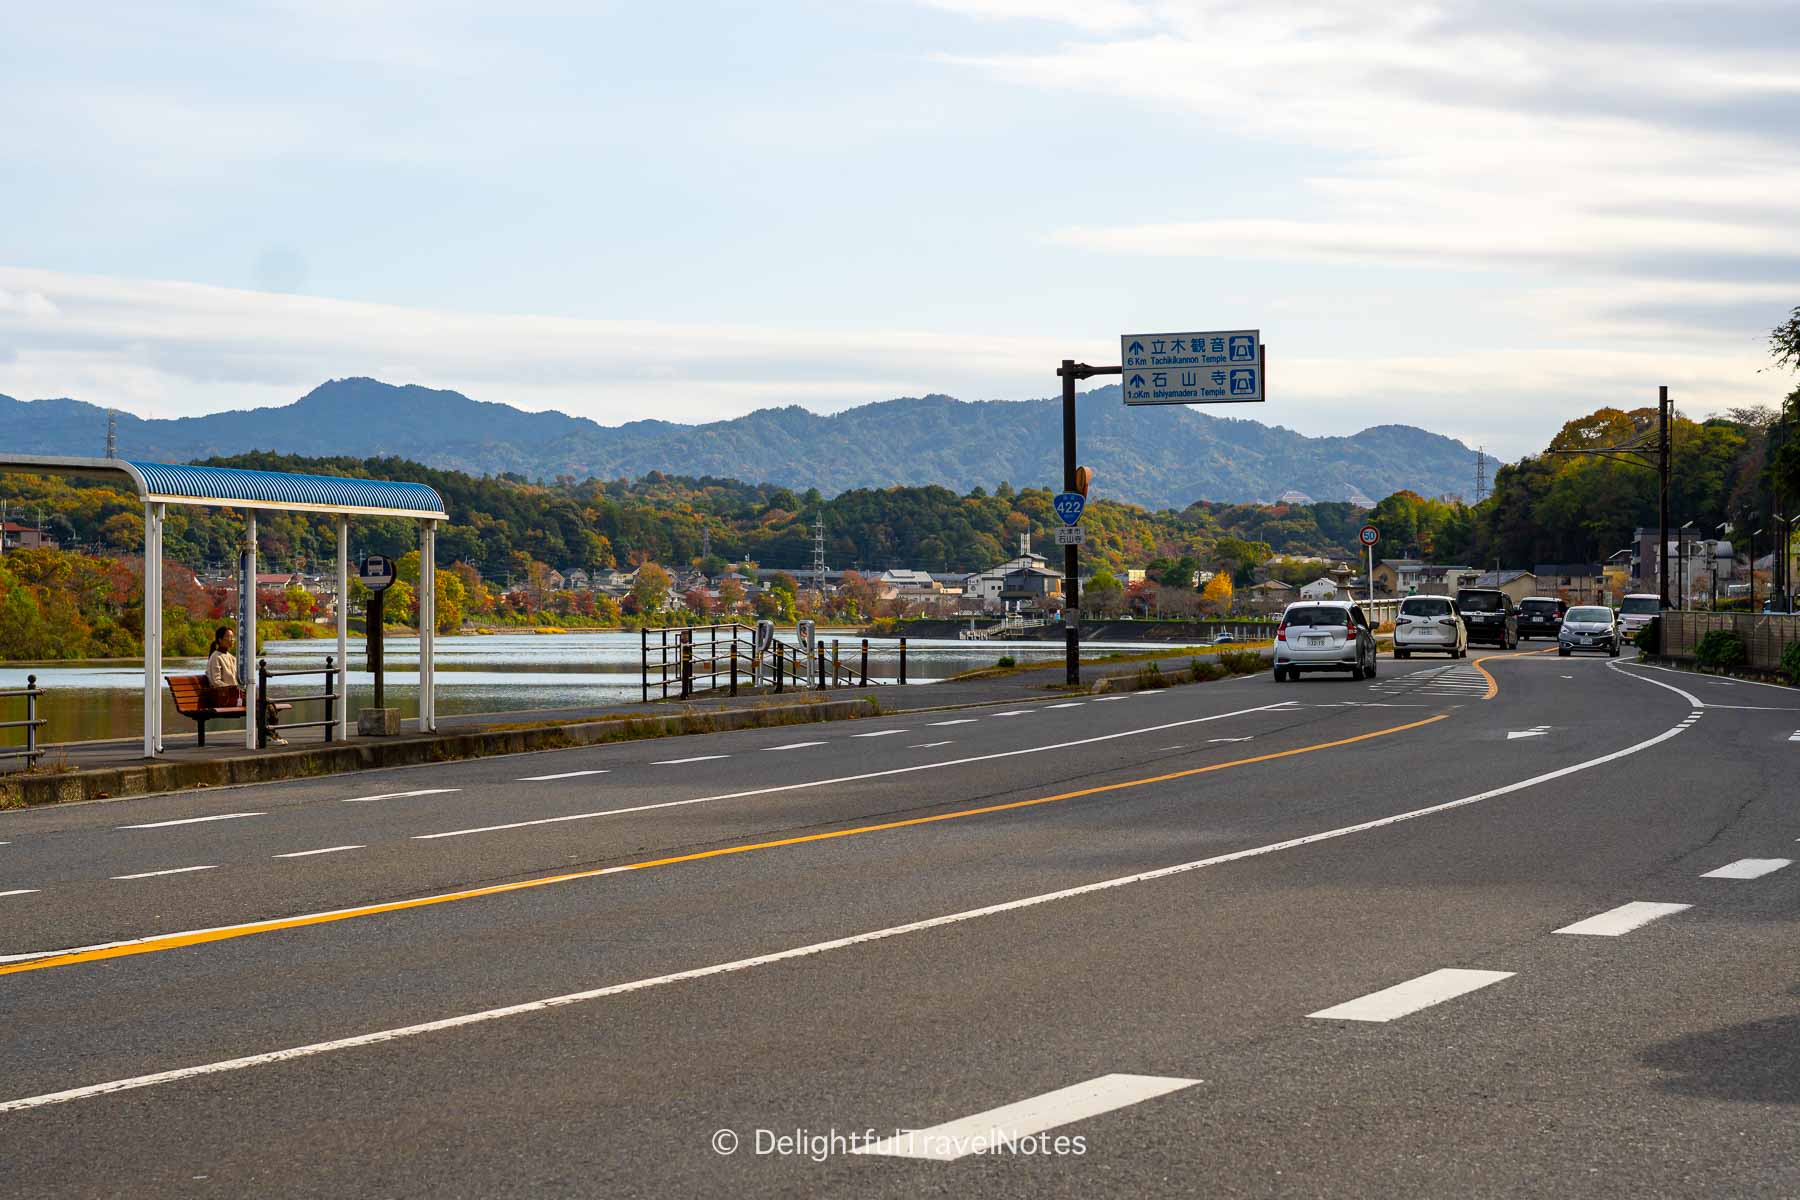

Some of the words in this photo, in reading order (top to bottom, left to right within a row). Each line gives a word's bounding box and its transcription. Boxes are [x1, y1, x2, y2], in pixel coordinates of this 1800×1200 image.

[1151, 337, 1225, 355] 立木観音
[1151, 355, 1199, 366] Tachikikannon
[1201, 354, 1227, 364] Temple
[1151, 369, 1227, 388] 石山寺
[1153, 389, 1198, 400] Ishiyamadera
[1201, 387, 1226, 398] Temple
[1057, 502, 1081, 513] 422
[1363, 531, 1376, 541] 50
